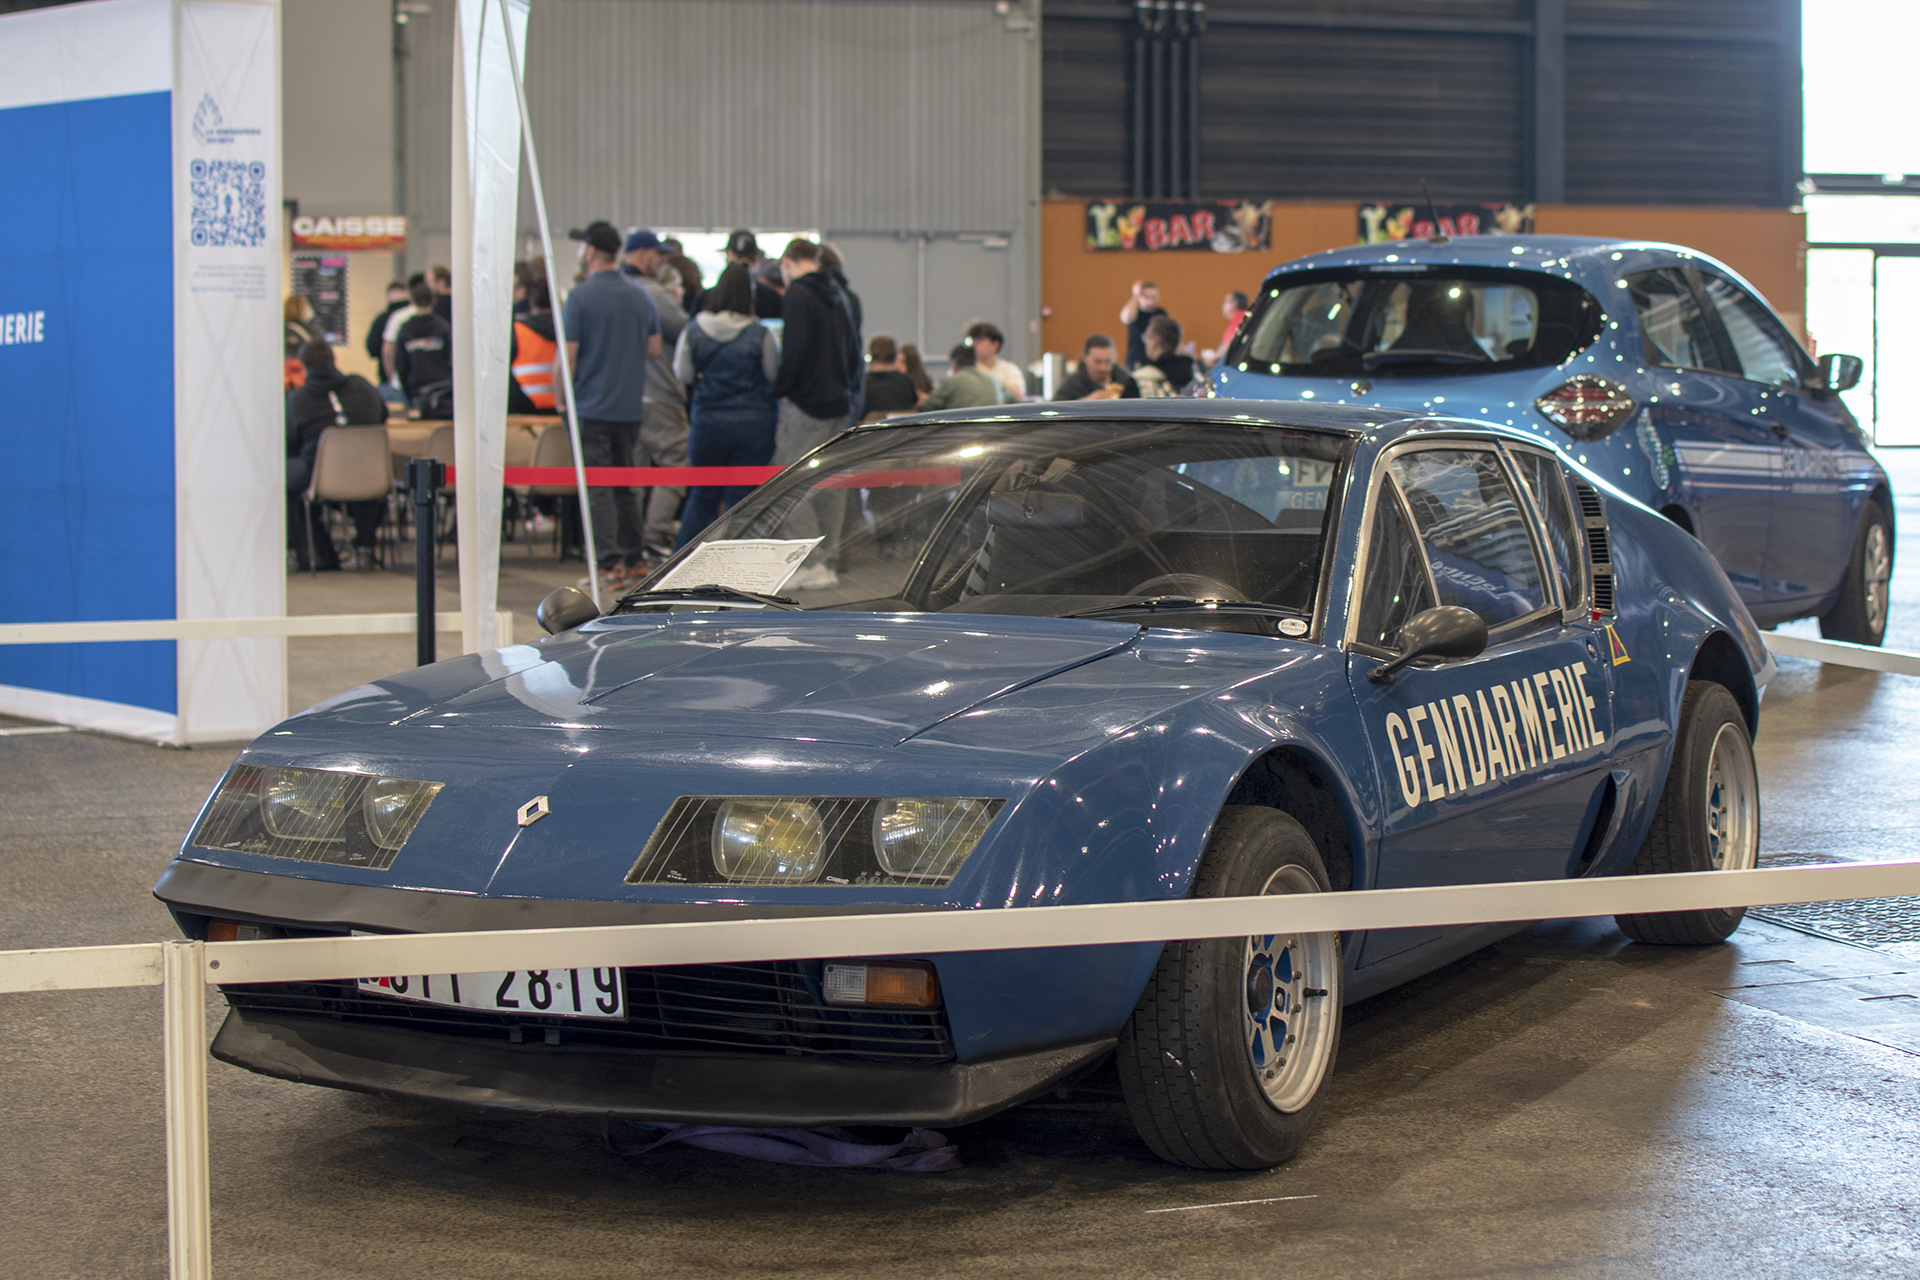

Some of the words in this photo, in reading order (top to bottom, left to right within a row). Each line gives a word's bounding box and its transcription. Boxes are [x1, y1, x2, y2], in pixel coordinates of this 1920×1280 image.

[293, 216, 405, 237] CAISSE
[1144, 210, 1214, 249] BAR
[1386, 661, 1605, 808] GENDARMERIE
[496, 966, 620, 1015] 2819
